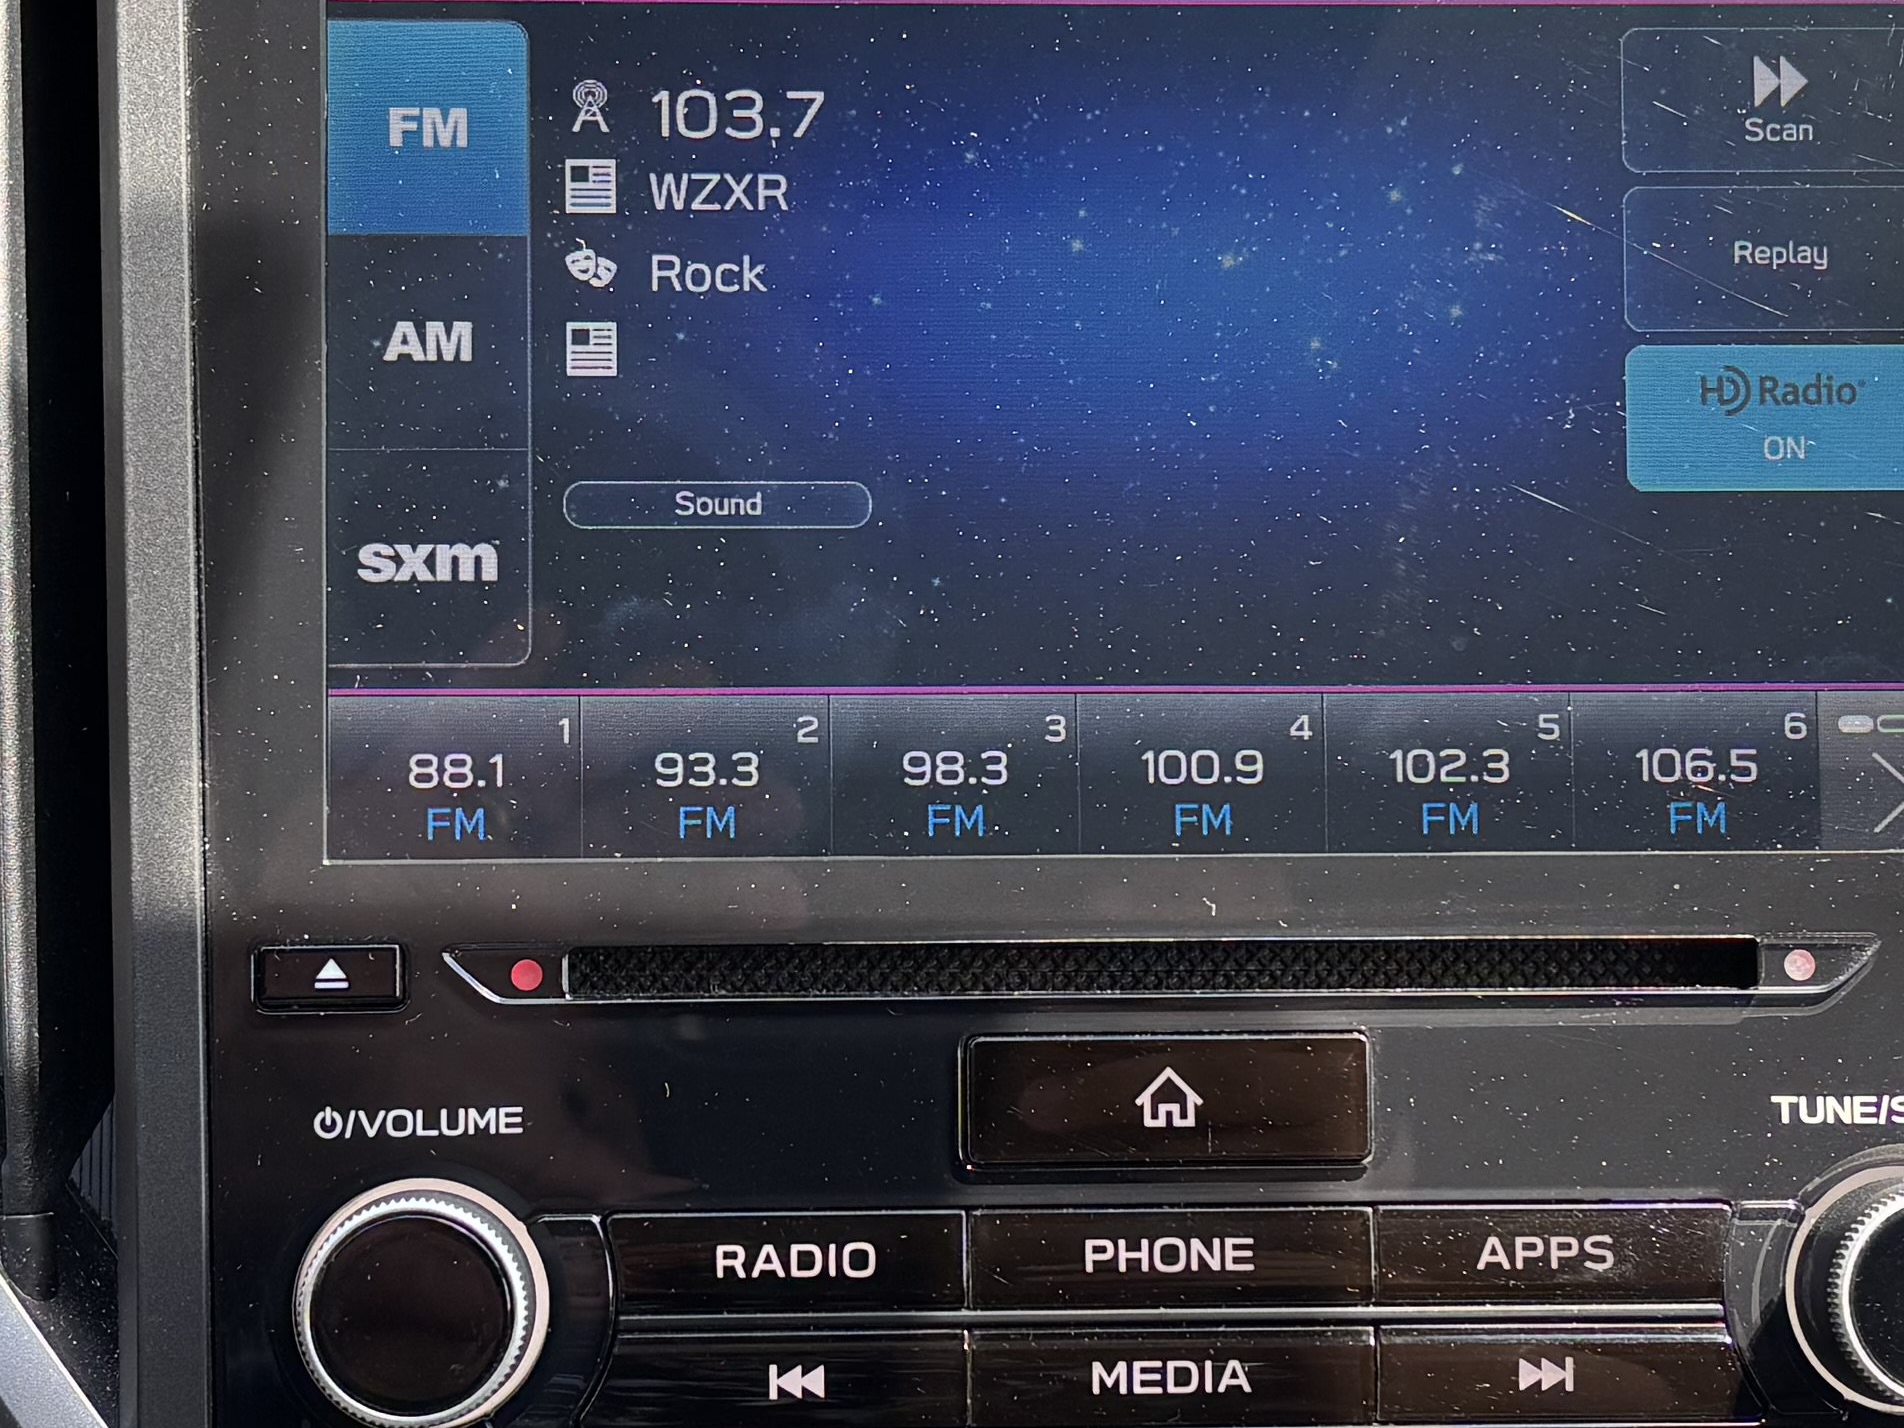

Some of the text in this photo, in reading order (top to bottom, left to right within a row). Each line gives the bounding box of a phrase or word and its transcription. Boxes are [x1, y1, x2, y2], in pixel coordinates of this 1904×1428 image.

[389, 106, 467, 147] FM
[652, 89, 824, 139] 103.7
[1745, 117, 1813, 141] Scan
[650, 173, 788, 210] WZXR
[1734, 240, 1827, 269] Replay
[652, 255, 767, 292] Rock
[383, 321, 472, 361] AM
[1764, 436, 1805, 460] ON
[675, 491, 762, 515] Sound
[357, 543, 498, 582] sxm
[559, 718, 569, 743] 1
[793, 715, 818, 742] 2
[1045, 714, 1066, 742] 3
[1290, 715, 1312, 740] 4
[1538, 714, 1559, 740] 5
[1785, 711, 1807, 739] 6
[409, 753, 502, 788] 88.1
[655, 752, 758, 787] 93.3
[903, 750, 1007, 785] 98.3
[1142, 750, 1263, 784] 100.9
[1389, 749, 1509, 783] 102.3
[1636, 747, 1757, 782] 106.5
[428, 808, 485, 840] FM
[679, 806, 735, 839] FM
[928, 804, 986, 837] FM
[1175, 804, 1232, 836] FM
[1423, 802, 1478, 834] FM
[1667, 802, 1726, 834] FM
[716, 1242, 876, 1278] RADIO
[1085, 1237, 1254, 1273] PHONE
[1477, 1235, 1614, 1272] APPS
[1092, 1360, 1251, 1394] MEDIA
